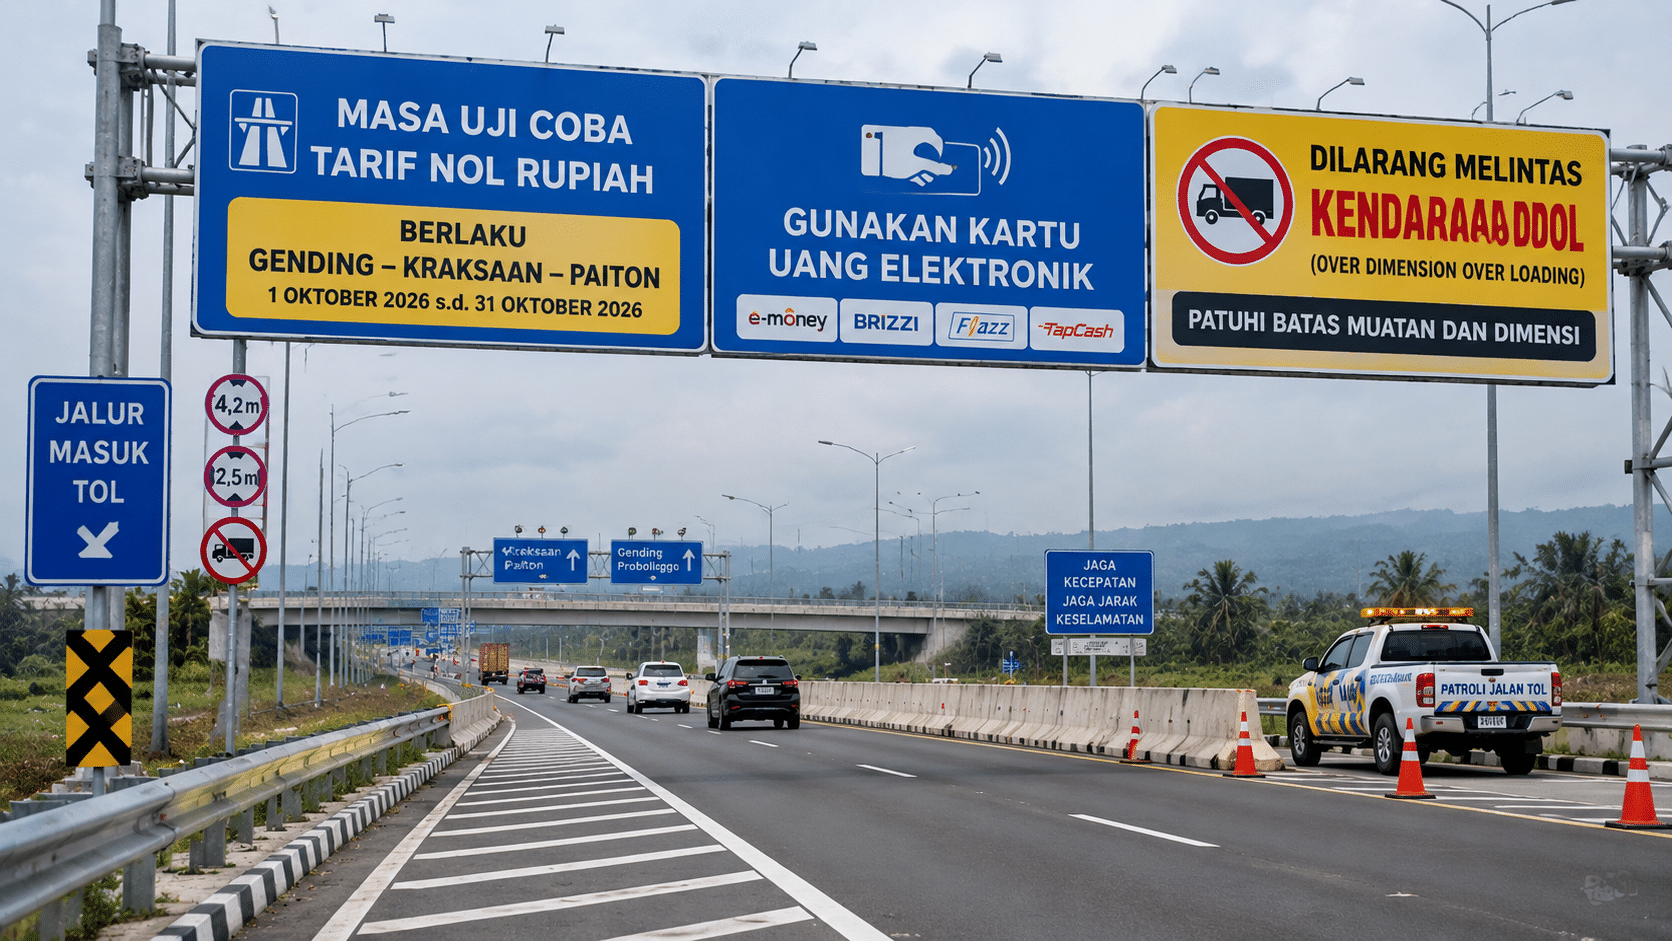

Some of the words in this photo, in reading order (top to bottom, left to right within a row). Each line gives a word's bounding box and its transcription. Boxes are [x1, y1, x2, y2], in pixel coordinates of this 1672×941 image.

[338, 97, 450, 134] MASA
[460, 105, 517, 138] UJI
[529, 109, 633, 145] COBA
[310, 145, 418, 181] TARIF
[430, 152, 505, 186] NOL
[517, 157, 653, 194] RUPIAH
[1310, 144, 1447, 179] DILARANG
[1455, 153, 1583, 187] MELINTAS
[400, 219, 526, 248] BERLAKU
[783, 207, 957, 244] GUNAKAN
[969, 216, 1080, 250] KARTU
[248, 247, 374, 277] GENDING
[403, 255, 543, 284] KRAKSAAN
[570, 263, 660, 289] PAITON
[769, 248, 868, 281] UANG
[881, 253, 1095, 291] ELEKTRONIK
[1310, 253, 1361, 276] (OVER
[1366, 257, 1457, 279] DIMENSION
[1462, 261, 1505, 282] OVER
[1510, 264, 1585, 289] LOADING)
[268, 286, 276, 303] 1
[283, 286, 378, 308] OKTOBER
[383, 291, 430, 310] 2026
[435, 293, 469, 312] s.d.
[474, 294, 496, 312] 31
[501, 295, 592, 316] OKTOBER
[597, 300, 643, 318] 2026
[748, 308, 828, 332] e-money
[853, 313, 919, 332] BRIZZI
[955, 315, 1011, 338] Flazz
[1038, 321, 1114, 340] TapCash
[1188, 308, 1265, 332] PATUHI
[1273, 312, 1340, 335] BATAS
[1347, 315, 1435, 340] MUATAN
[1442, 320, 1487, 342] DAN
[1494, 322, 1580, 345] DIMENSI
[55, 401, 144, 425] JALUR
[49, 440, 149, 464] MASUK
[72, 479, 125, 503] TOL
[617, 547, 663, 560] Gending
[1083, 559, 1117, 571] JAGA
[1064, 576, 1136, 588] KECEPATAN
[1062, 595, 1095, 607] JAGA
[1098, 595, 1138, 607] JARAK
[1056, 613, 1144, 625] KESELAMATAN
[1440, 682, 1486, 696] PATROLI
[1488, 682, 1524, 696] JALAN
[1526, 682, 1548, 696] TOL
